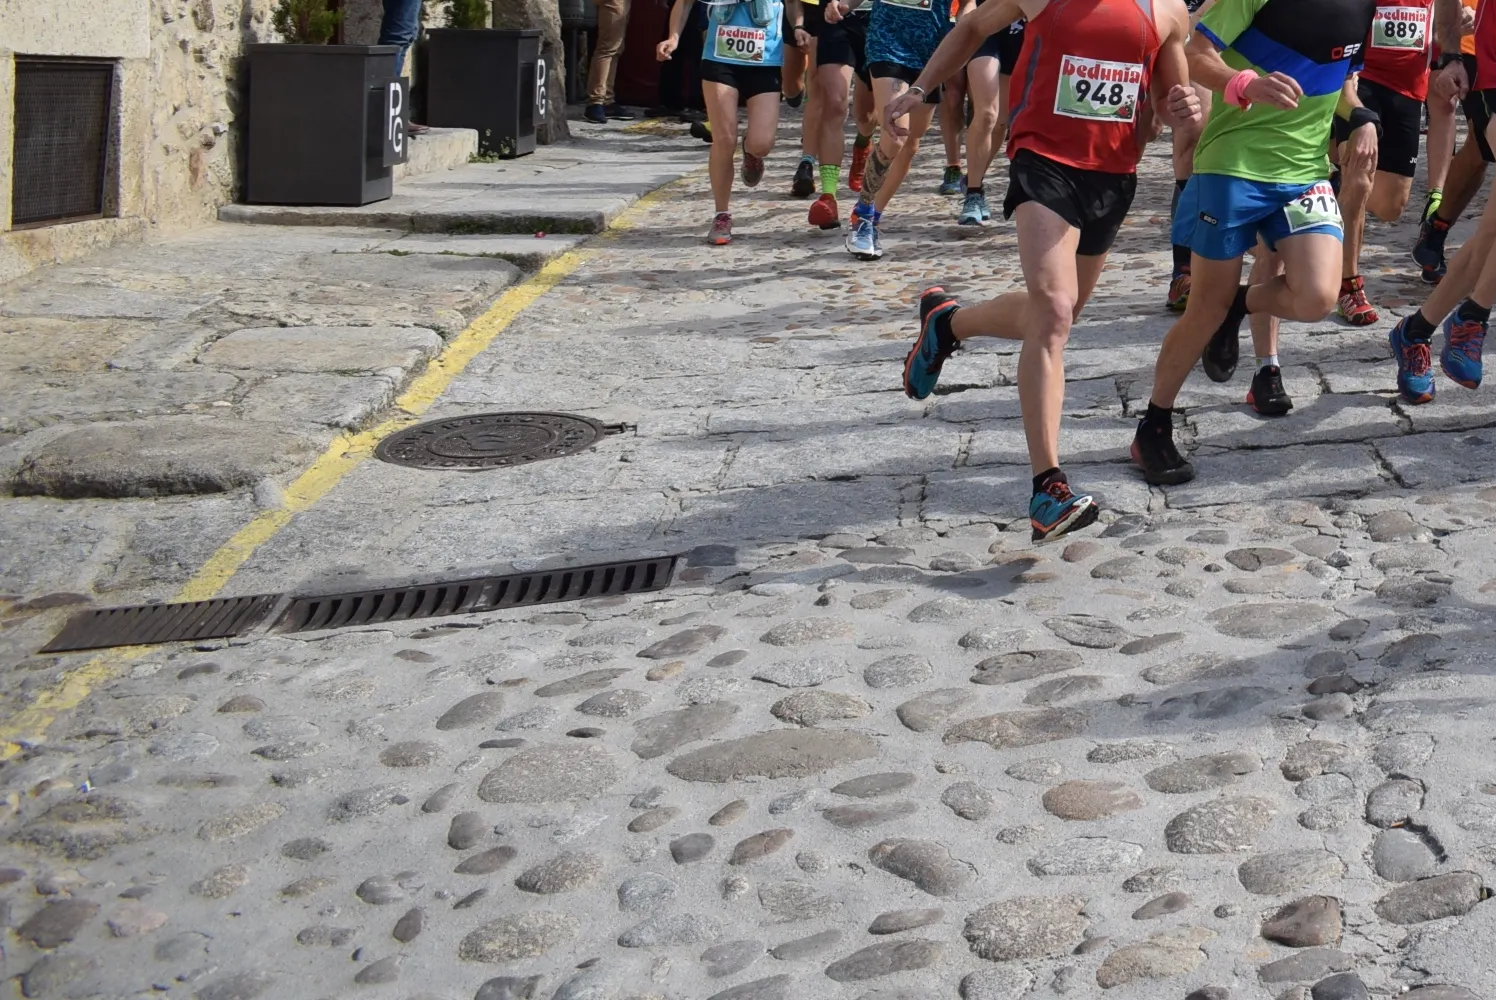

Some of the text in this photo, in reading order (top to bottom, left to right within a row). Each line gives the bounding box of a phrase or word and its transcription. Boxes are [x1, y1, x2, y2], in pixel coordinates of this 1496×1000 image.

[1374, 9, 1426, 22] bedunia
[717, 27, 765, 41] bedunia
[1384, 21, 1417, 38] 889
[725, 38, 755, 53] 900
[1062, 59, 1141, 84] bedunia
[1075, 79, 1123, 106] 948
